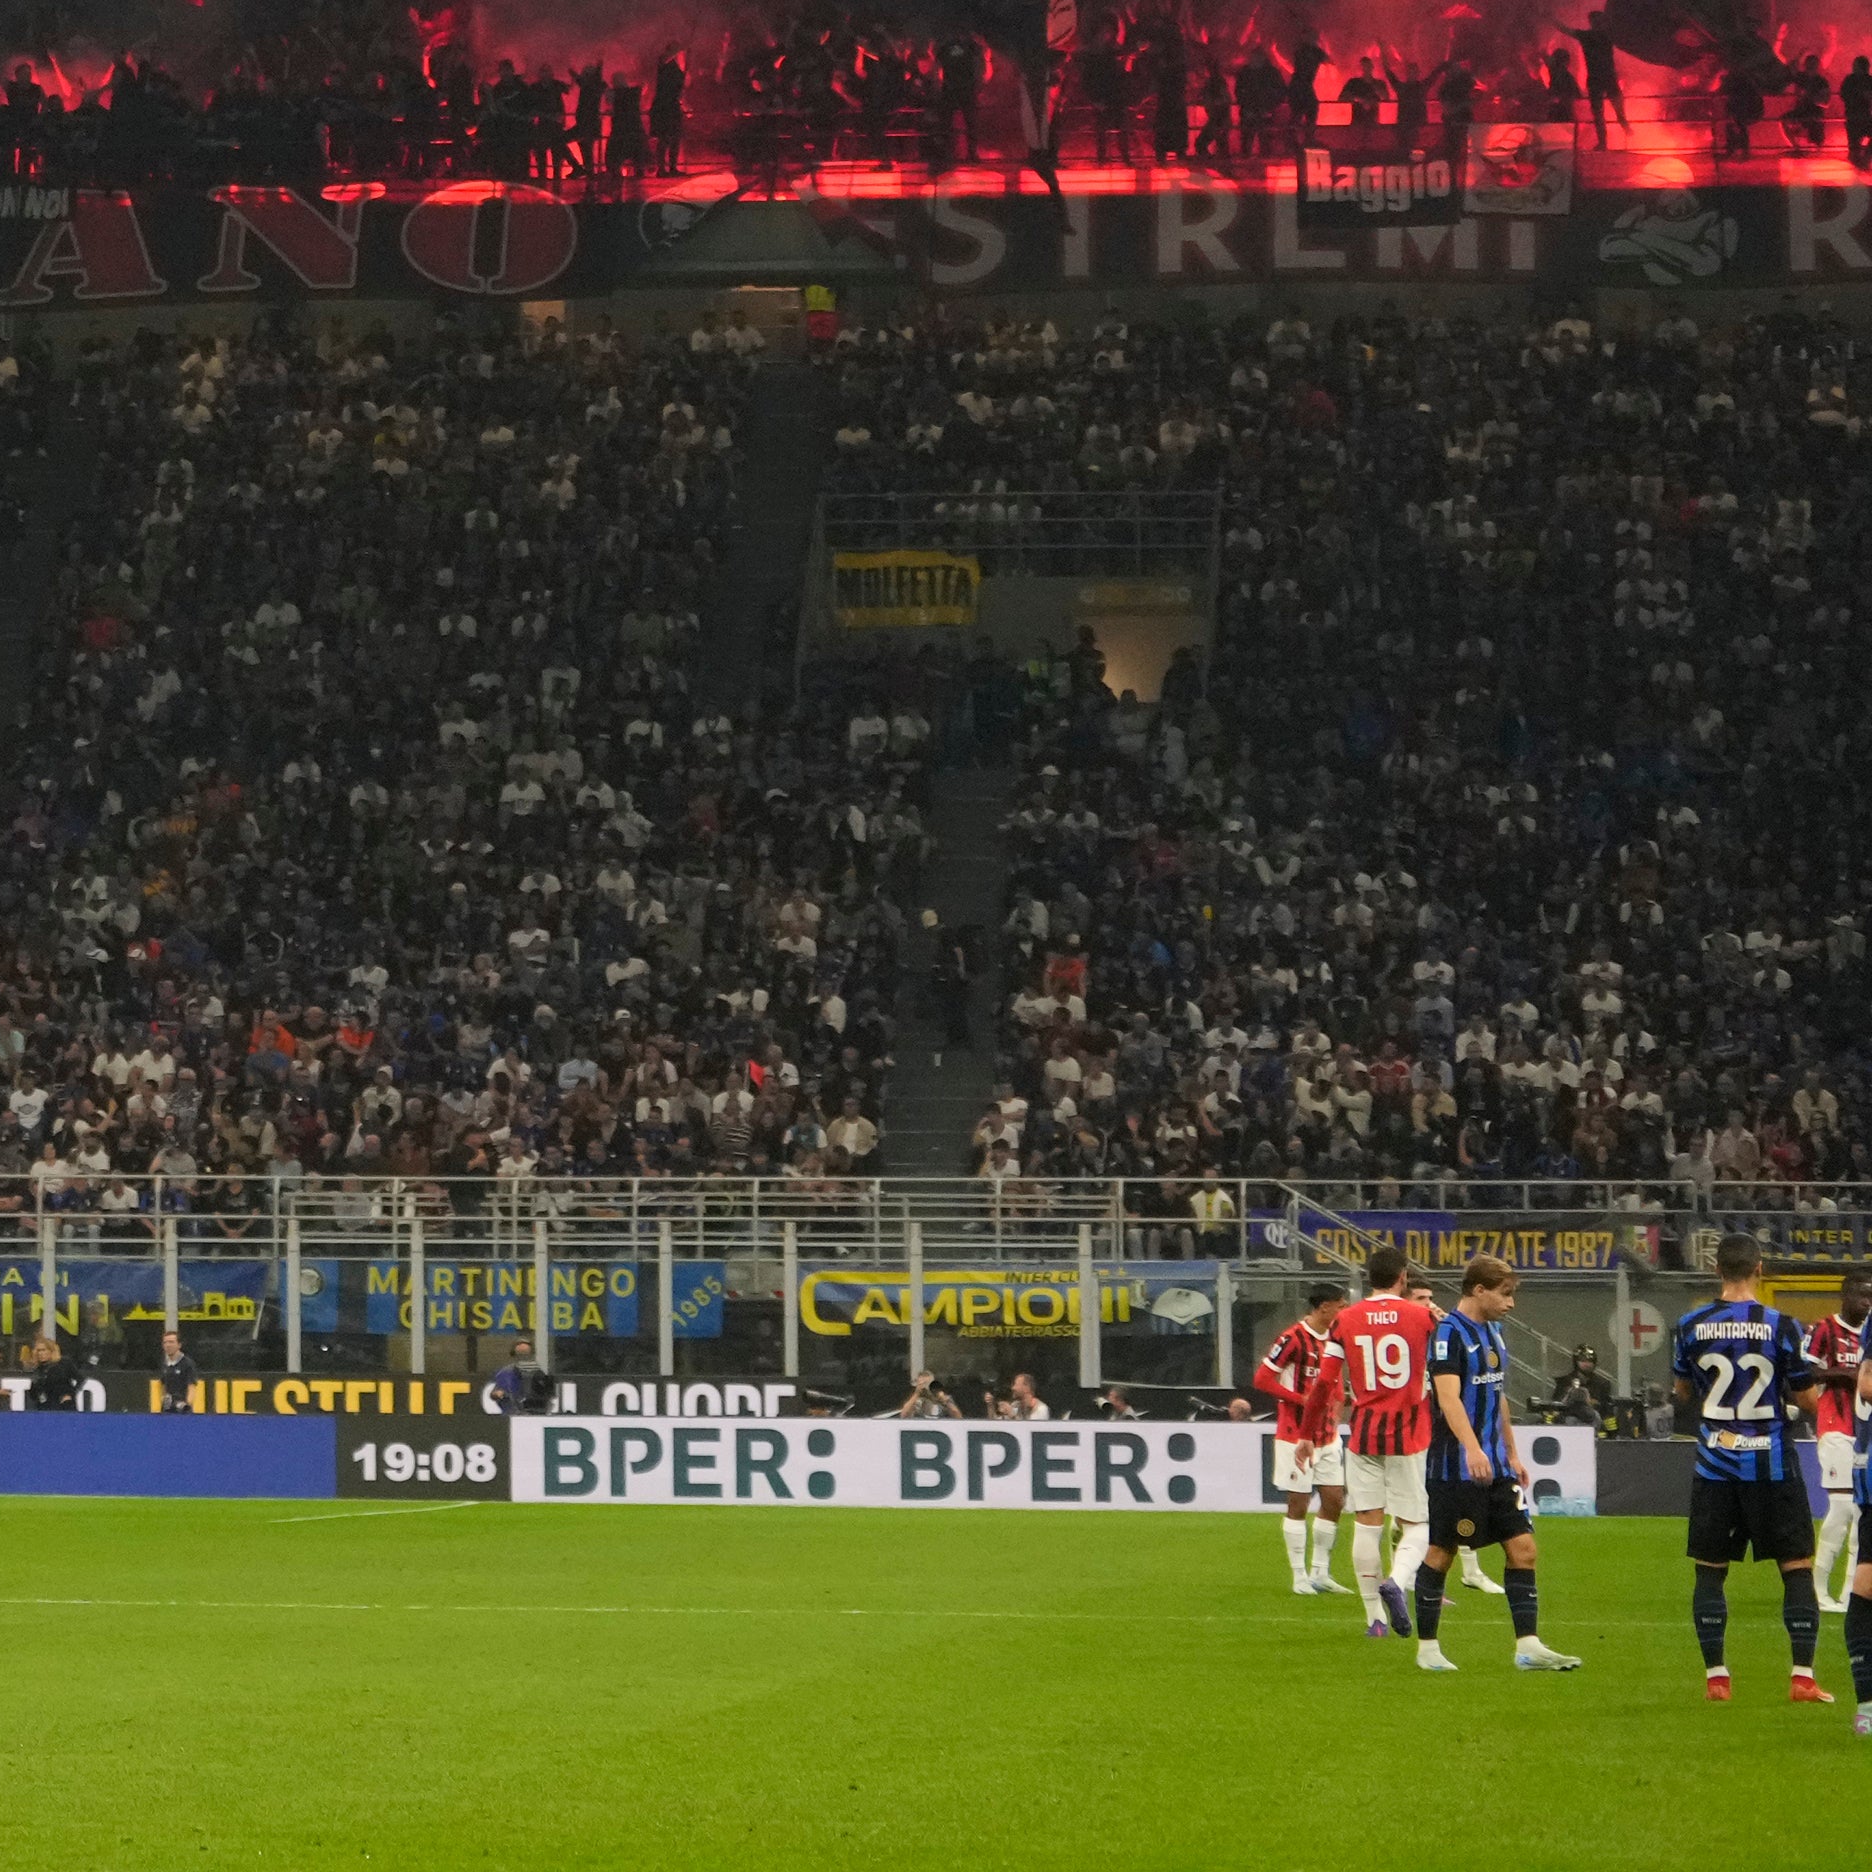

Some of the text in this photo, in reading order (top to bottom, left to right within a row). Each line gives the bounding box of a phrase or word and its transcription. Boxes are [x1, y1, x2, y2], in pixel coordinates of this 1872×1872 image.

[1304, 148, 1451, 213] Baggio
[1405, 1231, 1430, 1268] DI
[1438, 1231, 1547, 1269] MEZZATE
[1554, 1230, 1614, 1270] 1987
[1788, 1229, 1853, 1245] INTER
[669, 1274, 724, 1328] 1985
[798, 1270, 1130, 1337] CAMPIONI
[1366, 1311, 1398, 1325] THEO
[1695, 1322, 1772, 1341] MKHITARYAN
[1354, 1333, 1411, 1392] 19
[1696, 1352, 1776, 1421] 22
[352, 1441, 498, 1484] 19:08
[1512, 1484, 1528, 1511] 2
